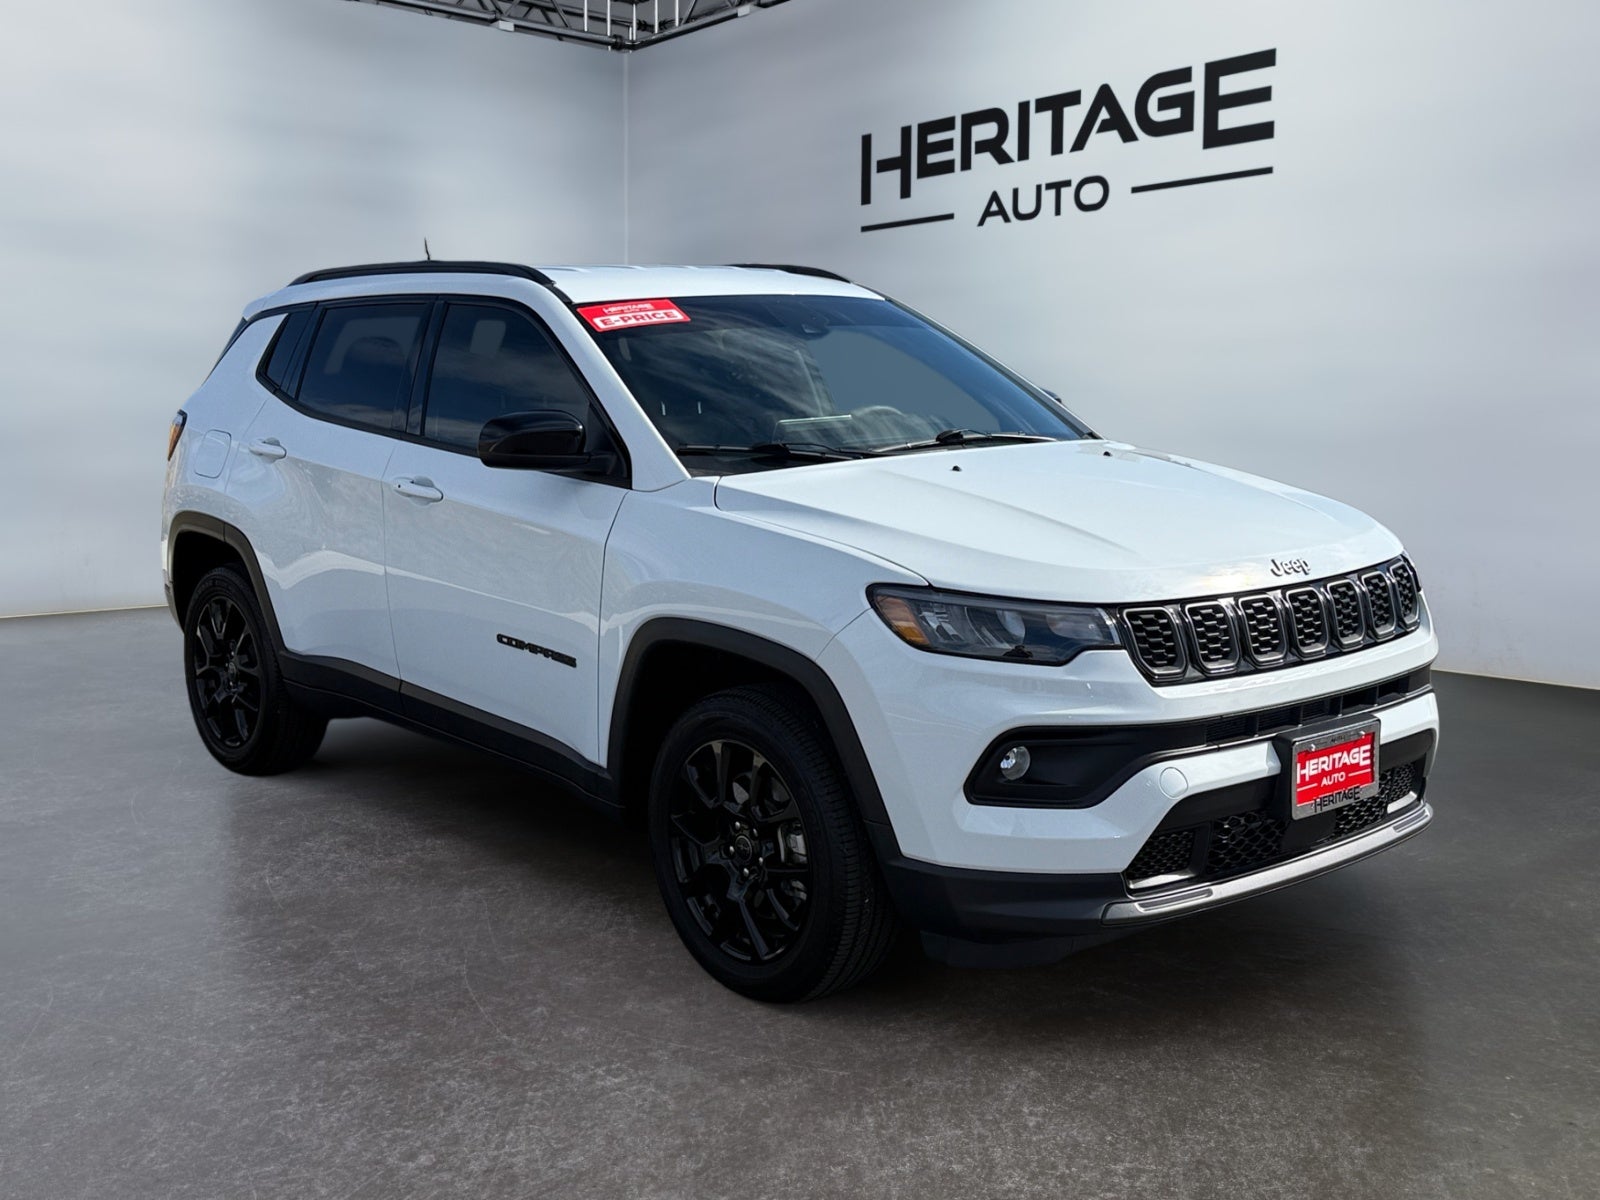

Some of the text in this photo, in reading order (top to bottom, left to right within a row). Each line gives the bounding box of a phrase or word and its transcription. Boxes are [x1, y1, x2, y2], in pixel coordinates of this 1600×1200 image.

[861, 48, 1277, 206] HERITAGE
[977, 175, 1110, 227] AUTO
[599, 311, 678, 326] E-PRICE
[1270, 558, 1311, 577] Jeep
[1296, 744, 1372, 784] HERITAGE
[1321, 772, 1346, 787] AUTO
[1313, 786, 1362, 813] HERITAGE
